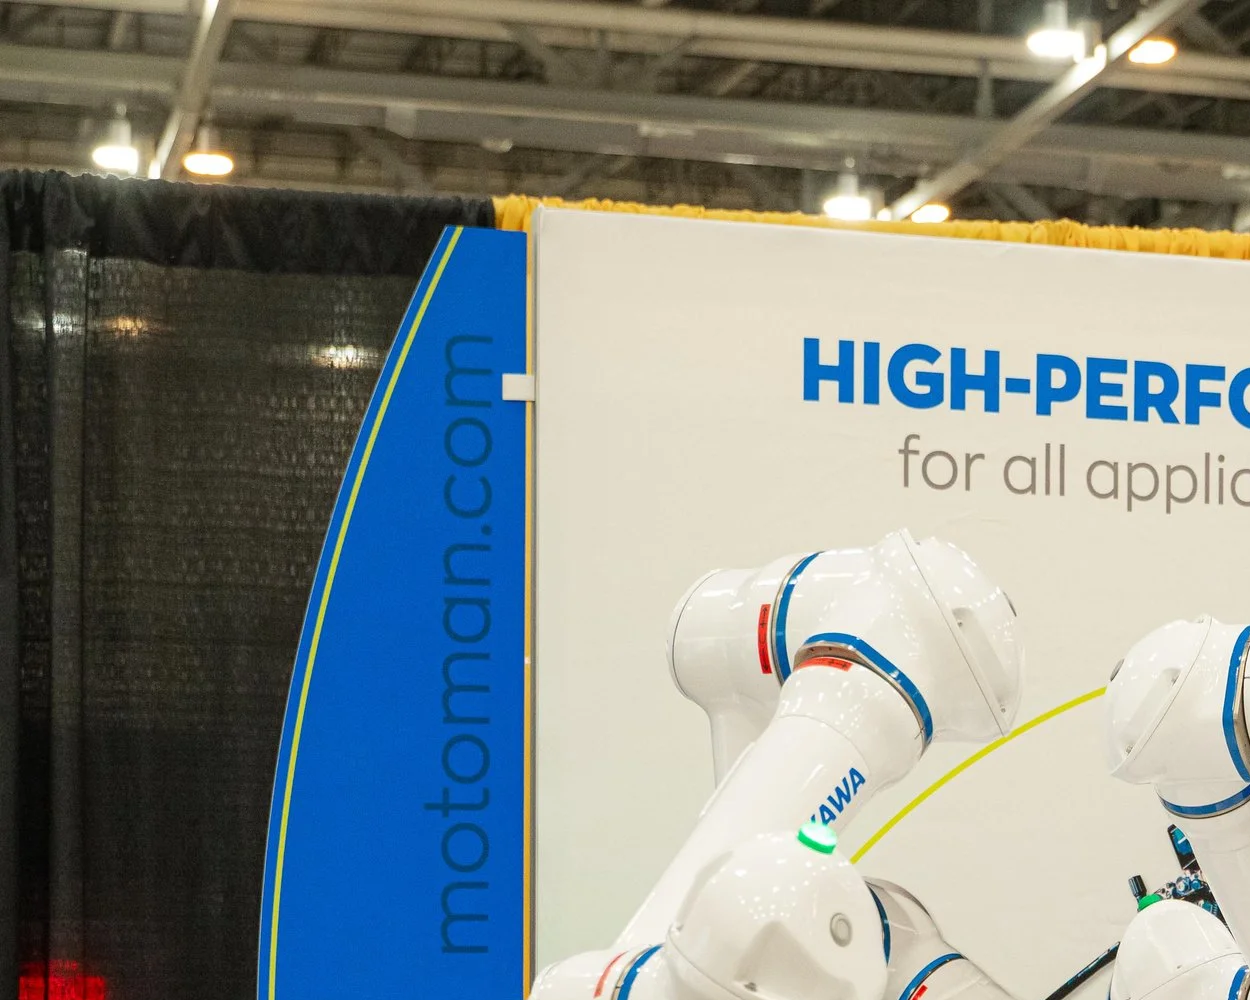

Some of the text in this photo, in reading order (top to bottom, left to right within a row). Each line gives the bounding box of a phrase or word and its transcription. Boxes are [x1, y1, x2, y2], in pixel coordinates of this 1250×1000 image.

[898, 434, 985, 491] for
[1003, 443, 1065, 496] all
[424, 333, 493, 954] motoman.com
